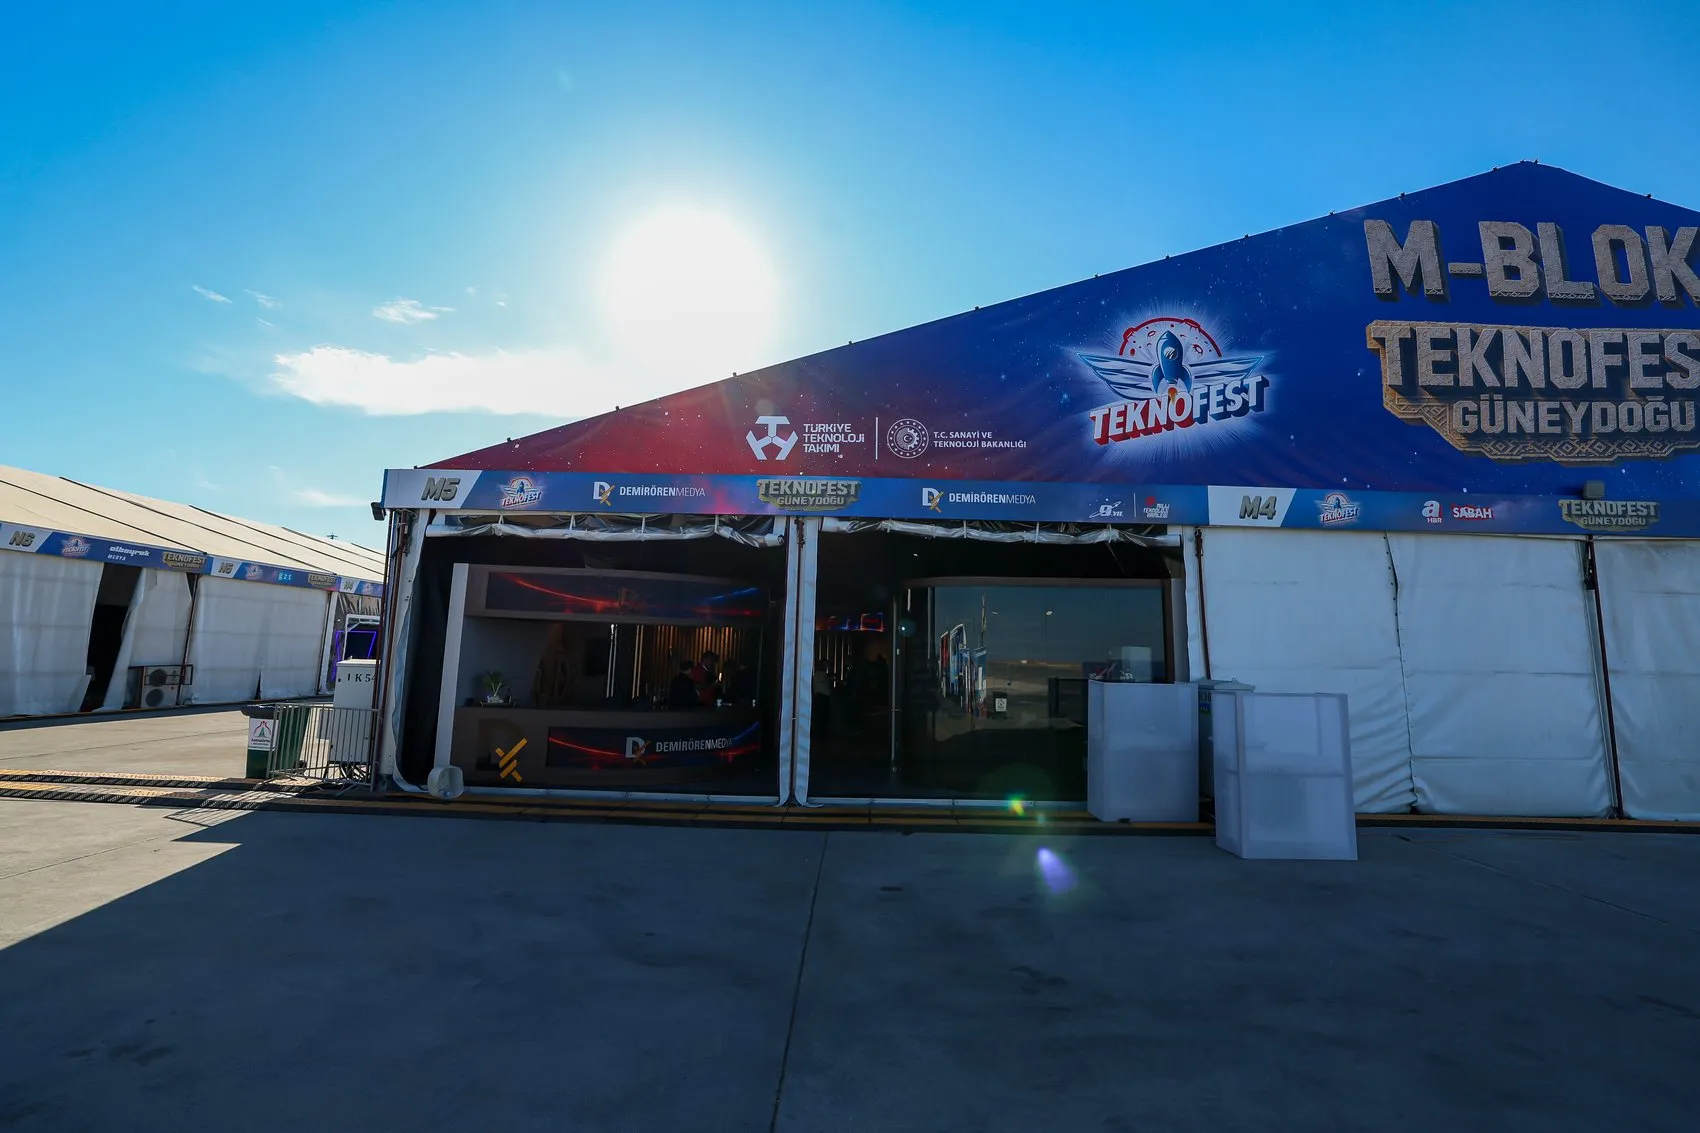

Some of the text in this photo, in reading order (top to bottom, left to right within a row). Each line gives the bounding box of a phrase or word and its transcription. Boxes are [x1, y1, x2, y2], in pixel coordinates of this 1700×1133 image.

[1363, 219, 1700, 303] M-BLOK
[1090, 375, 1269, 446] TEKNOFEST
[1452, 394, 1696, 434] GÜNEYDOĞU
[803, 423, 852, 433] TÜRKİYE
[933, 430, 992, 439] T.C. SANAYİ VE
[803, 433, 865, 443] TEKNOLOJİ
[933, 439, 1027, 448] TEKNOLOJİ BAKANLIĞI
[803, 443, 840, 453] TAKIMI
[421, 477, 461, 501] M5
[757, 480, 859, 495] TEKNOFEST
[501, 491, 541, 507] TEKNOFEST
[1239, 496, 1277, 520] M4
[1320, 508, 1359, 523] TEKNOFEST
[1453, 506, 1492, 519] SABAH
[1559, 500, 1658, 516] TEKNOFEST
[9, 531, 35, 547] N6
